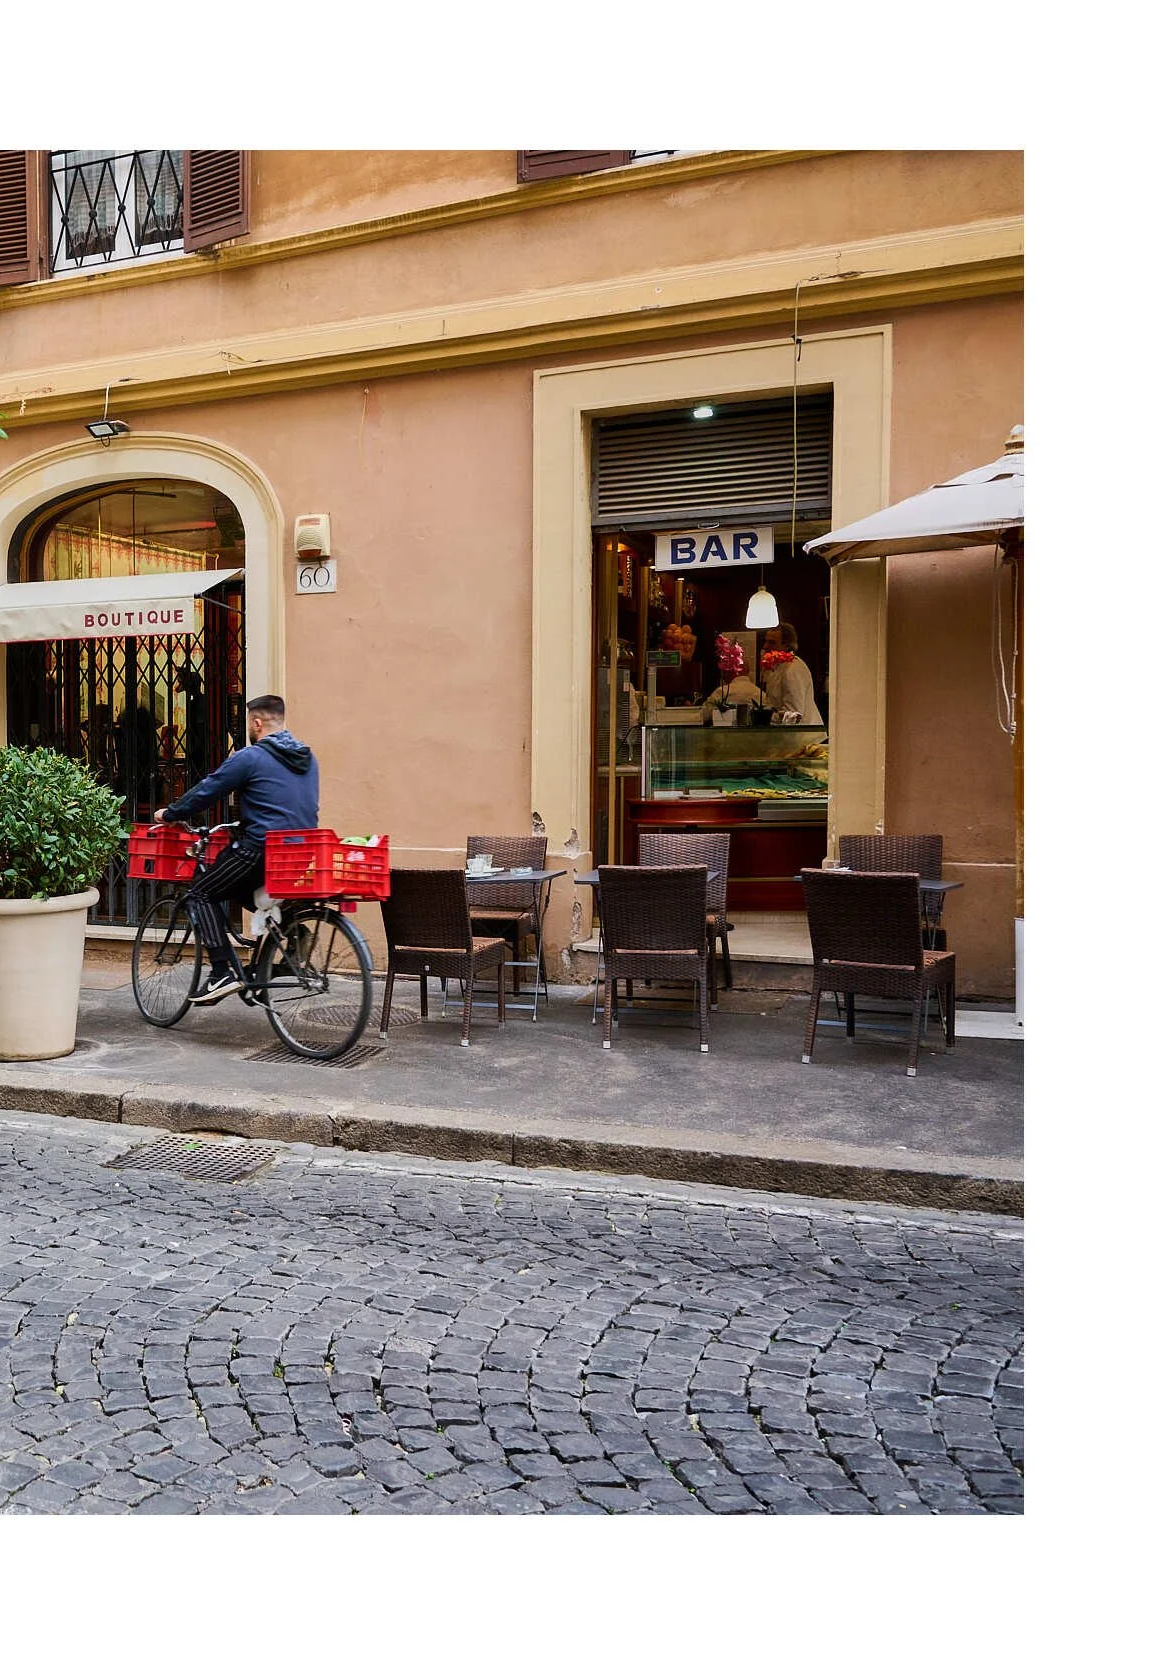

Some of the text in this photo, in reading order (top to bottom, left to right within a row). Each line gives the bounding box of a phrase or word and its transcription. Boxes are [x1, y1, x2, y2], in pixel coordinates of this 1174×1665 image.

[670, 532, 759, 565] BAR
[300, 566, 330, 588] 60
[85, 609, 184, 628] BOUTIQUE
